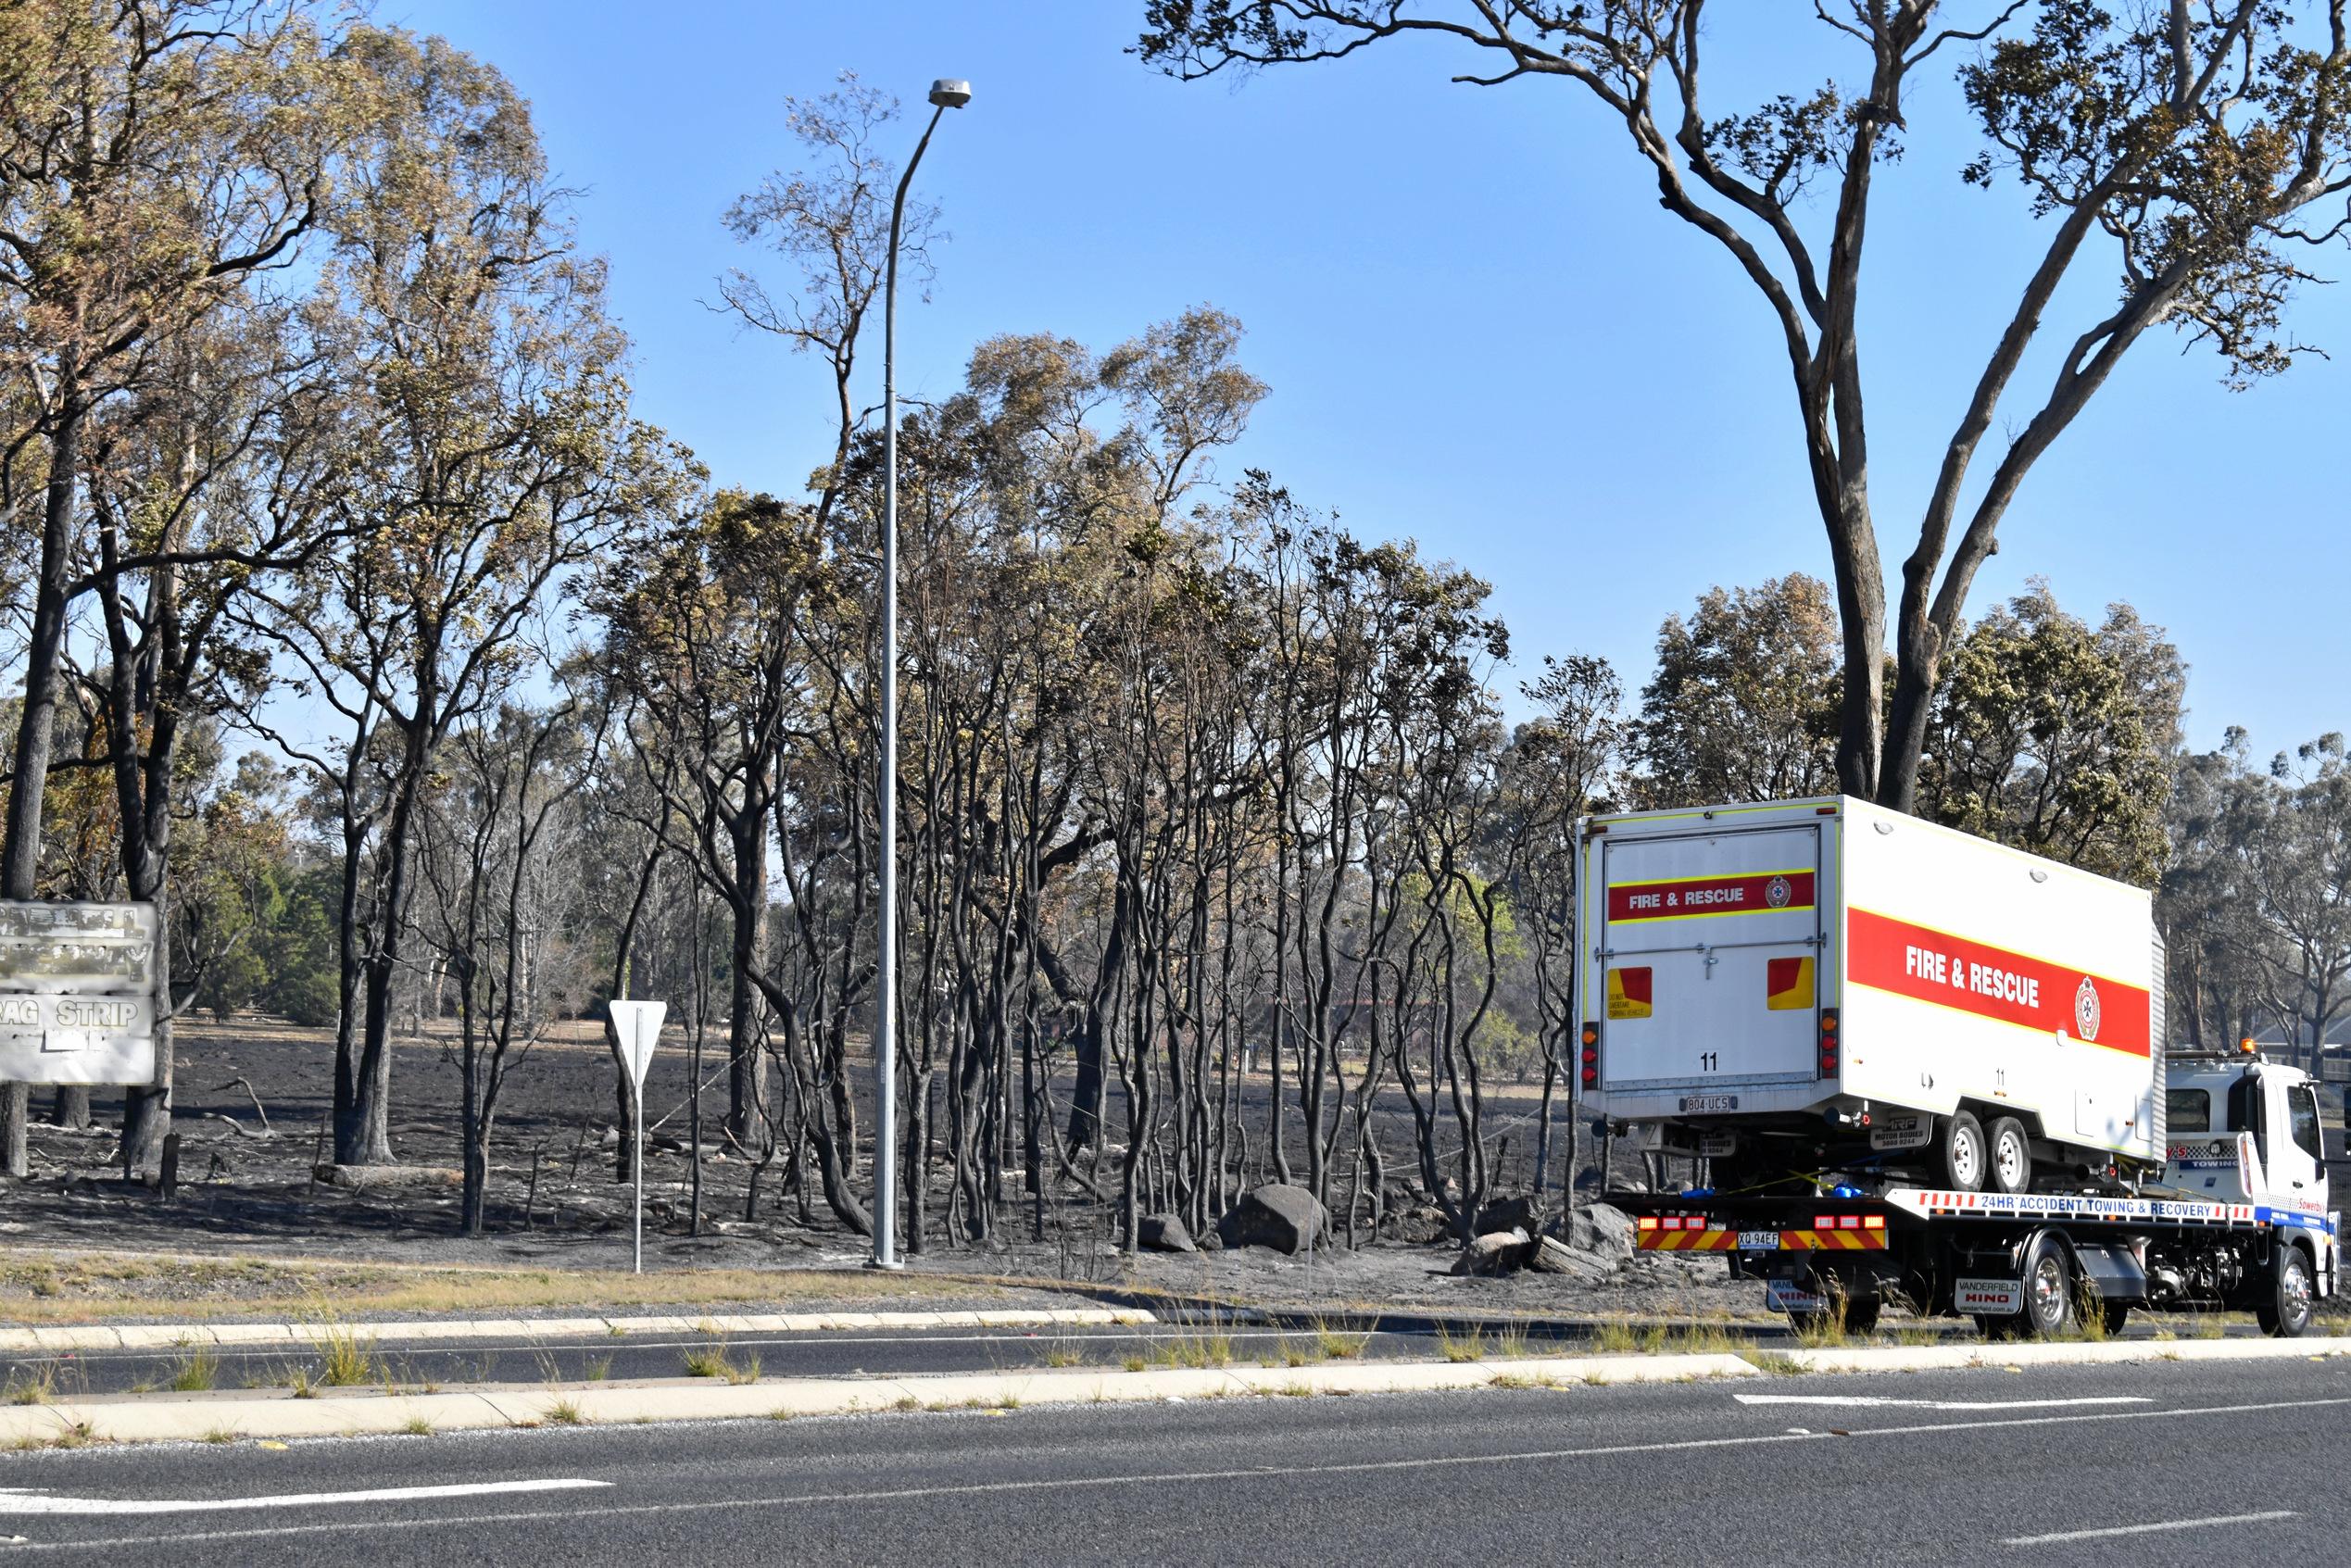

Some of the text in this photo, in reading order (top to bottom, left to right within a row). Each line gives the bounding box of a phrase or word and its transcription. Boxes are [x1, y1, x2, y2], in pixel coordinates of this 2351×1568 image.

[1629, 887, 1743, 909] FIRE & RESCUE
[1906, 945, 2039, 1009] FIRE & RESCUE
[0, 999, 138, 1027] AG STRIP
[1701, 1052, 1716, 1072] 11
[1996, 1067, 2005, 1086] 11
[1875, 1130, 1924, 1141] MOTOR BODIES
[1981, 1196, 2210, 1217] 24HR ACCIDENT TOWING & RECOVERY
[1959, 1281, 2018, 1292] VANDERFIELD
[1966, 1293, 2009, 1303] HINO
